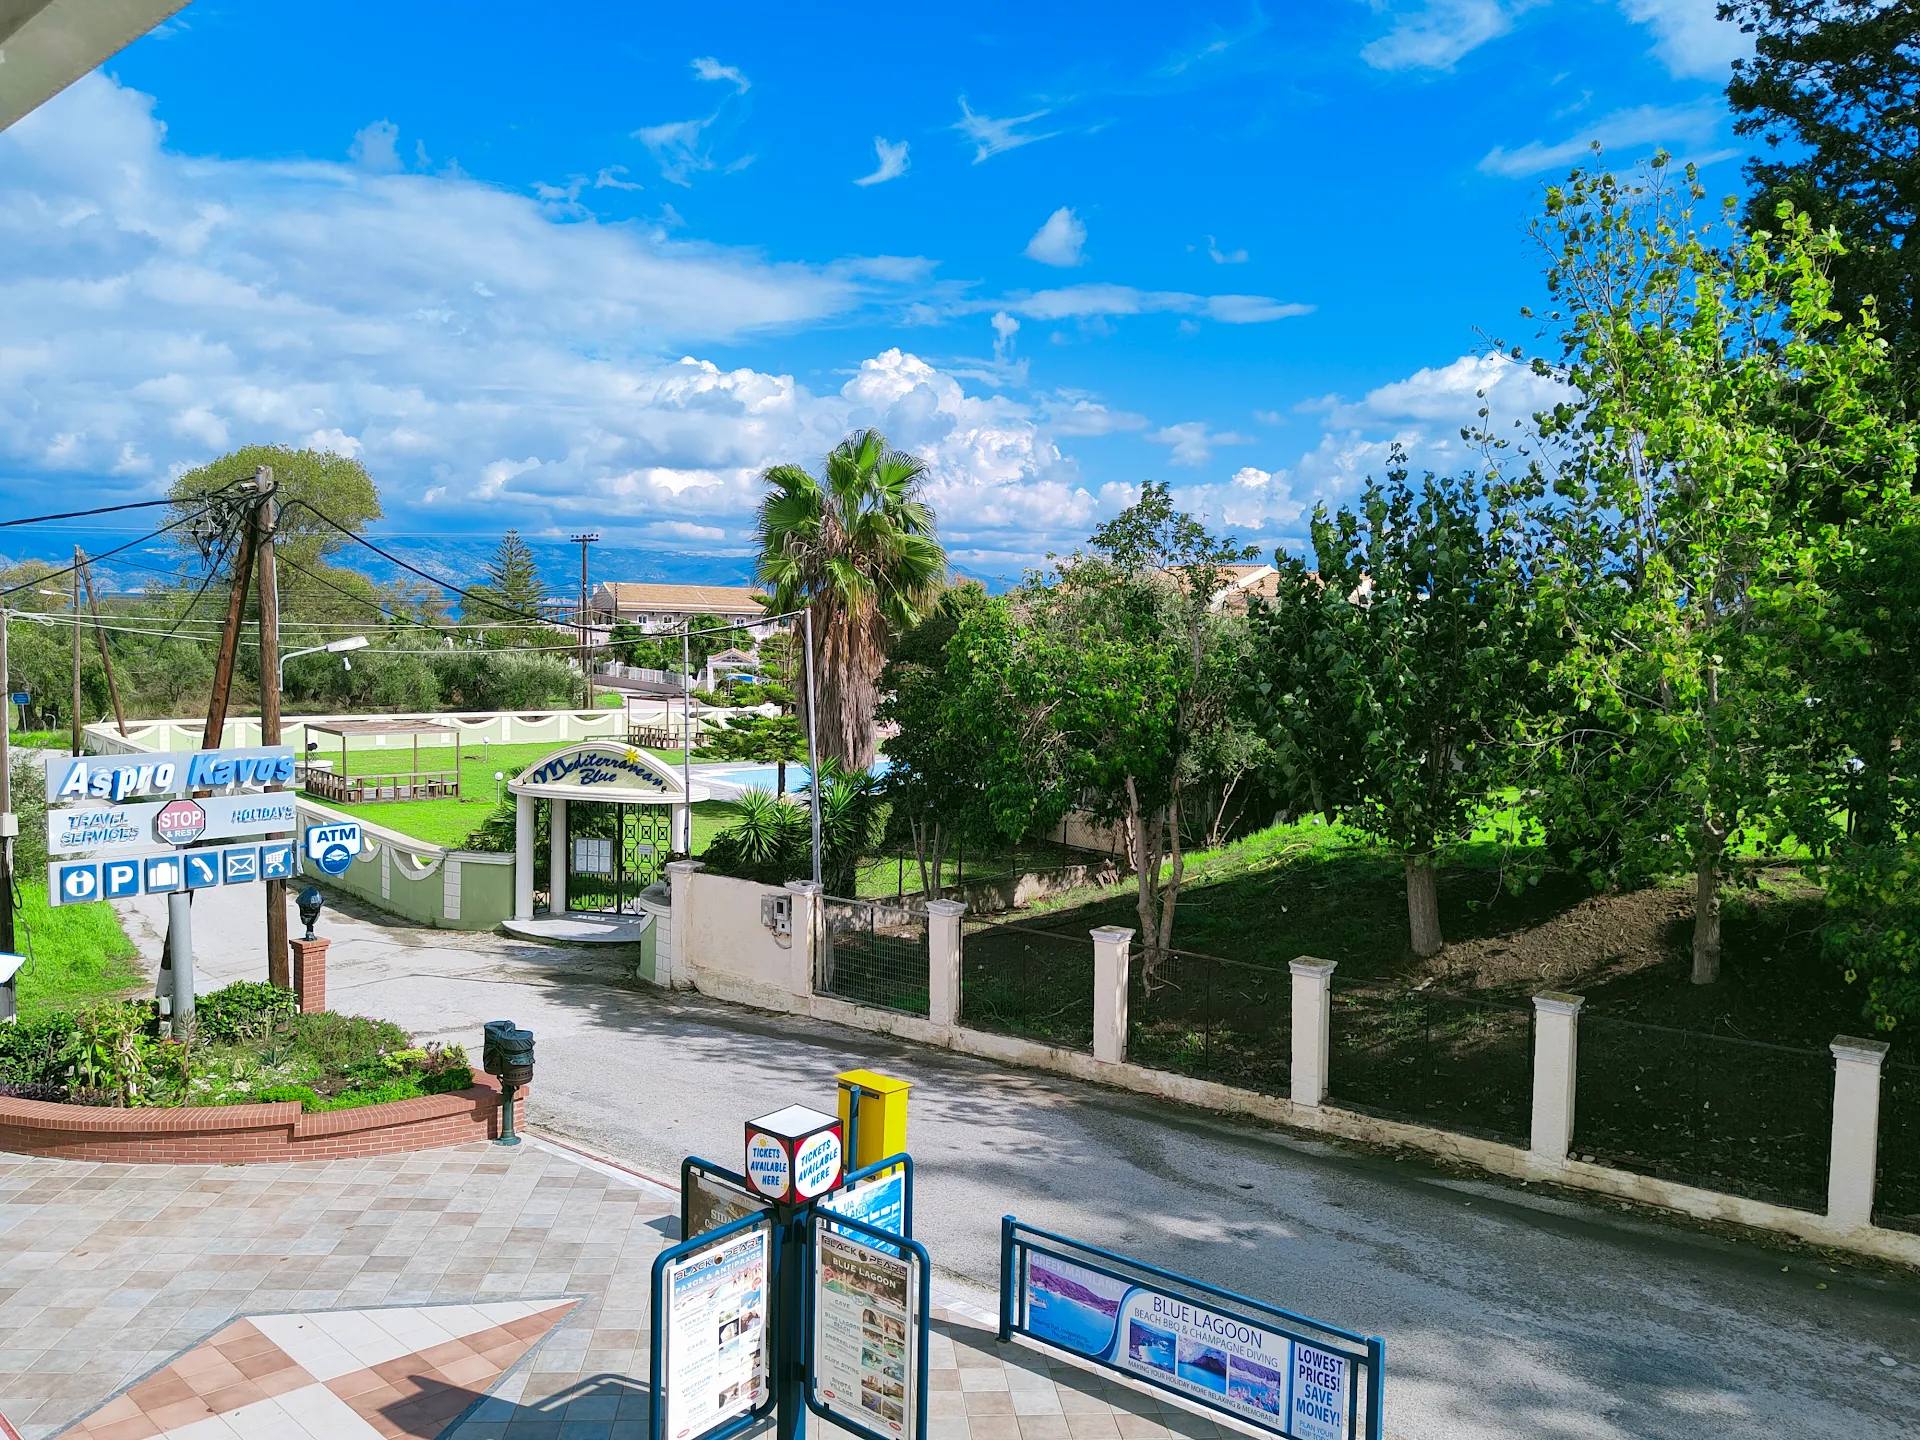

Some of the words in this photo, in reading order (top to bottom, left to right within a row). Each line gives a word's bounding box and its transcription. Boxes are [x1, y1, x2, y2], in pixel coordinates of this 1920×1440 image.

[58, 761, 175, 801] Aspro
[188, 753, 295, 785] Kavos
[533, 753, 663, 787] Mediterranean
[579, 768, 617, 785] Blue
[67, 811, 130, 831] TRAVEL
[161, 810, 202, 829] STOP
[231, 805, 294, 824] HOLIDAYS
[60, 827, 139, 847] SERVICES
[166, 830, 173, 838] &
[175, 828, 198, 838] REST
[316, 827, 356, 843] ATM
[111, 865, 134, 893] P
[750, 1160, 787, 1173] AVAILABLE
[752, 1147, 780, 1159] TICKETS
[798, 1147, 838, 1183] AVAILABLE
[801, 1139, 831, 1167] TICKETS
[762, 1175, 780, 1186] HERE
[810, 1166, 830, 1188] HERE
[674, 1258, 712, 1281] BLACK
[725, 1237, 761, 1259] PEARL
[824, 1235, 857, 1256] BLACK
[869, 1255, 906, 1276] PEARL
[675, 1276, 704, 1295] PAXOS
[706, 1273, 713, 1281] &
[714, 1251, 762, 1277] ANTIPAXOS
[832, 1257, 857, 1273] BLUE
[858, 1268, 896, 1289] LAGOON
[1032, 1253, 1064, 1273] GREEK
[1065, 1266, 1120, 1293] MAINLAND
[834, 1299, 850, 1310] CAVE
[1153, 1296, 1190, 1323] BLUE
[1194, 1310, 1262, 1349] LAGOON
[1134, 1307, 1161, 1326] BEACH
[1163, 1317, 1180, 1333] BBQ
[1182, 1325, 1188, 1334] &
[1189, 1328, 1245, 1356] CHAMPAGNE
[1246, 1348, 1278, 1368] DIVING
[1298, 1346, 1342, 1375] LOWEST
[1128, 1360, 1149, 1373] MAKING
[1149, 1368, 1165, 1379] YOUR
[1165, 1374, 1189, 1389] HOLIDAY
[1190, 1383, 1207, 1396] MORE
[1208, 1390, 1236, 1408] RELAXING
[1242, 1405, 1279, 1425] MEMORABLE
[1299, 1365, 1340, 1393] PRICES!
[1304, 1383, 1333, 1407] SAVE
[1296, 1397, 1340, 1428] MONEY!
[1299, 1419, 1316, 1432] PLAN
[1317, 1425, 1334, 1439] YOUR
[1299, 1427, 1311, 1437] TRIP
